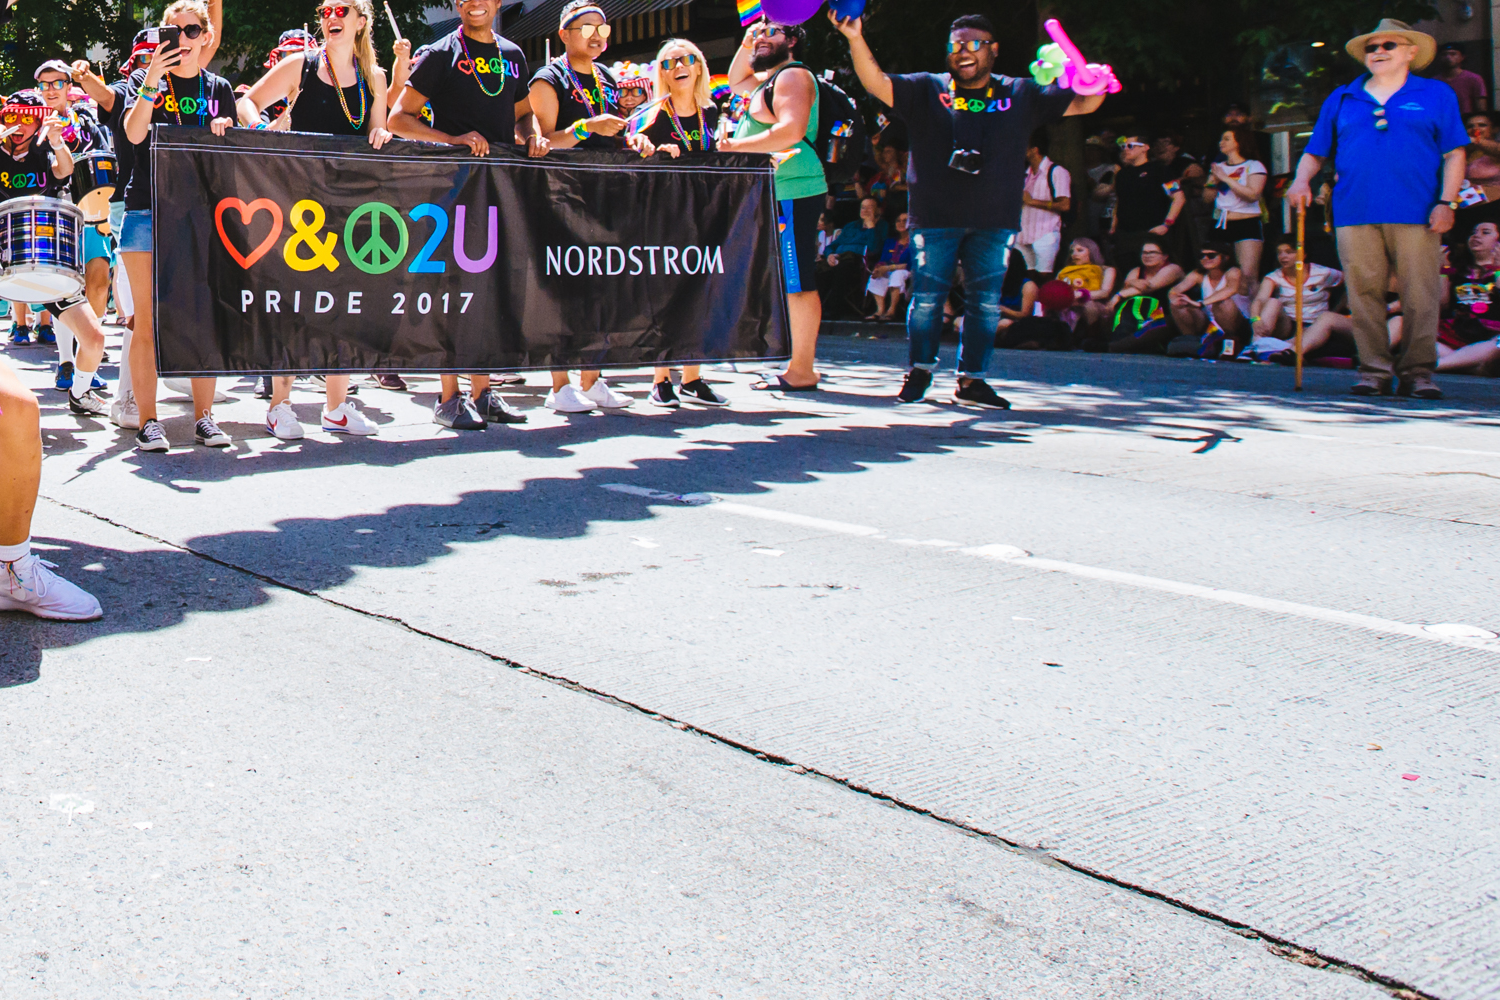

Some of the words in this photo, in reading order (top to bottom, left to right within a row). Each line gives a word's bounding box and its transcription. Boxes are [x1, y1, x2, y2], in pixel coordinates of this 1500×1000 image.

[546, 245, 724, 276] NORDSTROM
[241, 290, 363, 314] PRIDE
[392, 292, 475, 315] 2017
